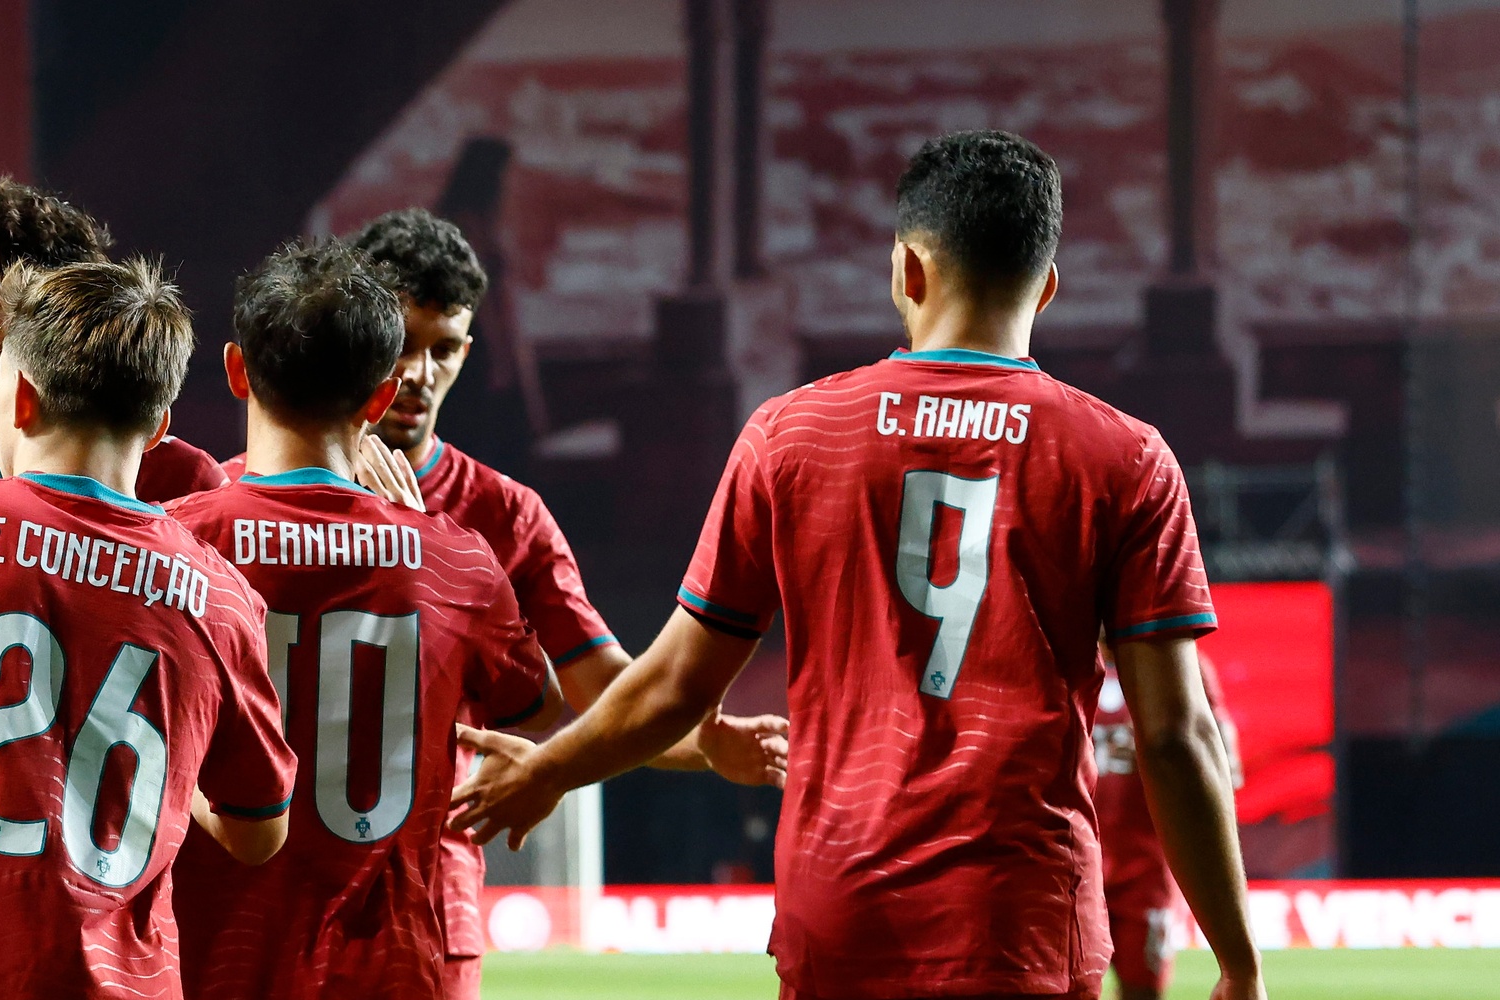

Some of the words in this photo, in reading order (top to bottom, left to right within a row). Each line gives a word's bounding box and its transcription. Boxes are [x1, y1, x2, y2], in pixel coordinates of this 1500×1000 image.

[876, 391, 906, 436] G.
[913, 395, 1032, 445] RAMOS
[15, 519, 210, 620] CONCEIÇÃO
[233, 517, 423, 570] BERNARDO
[895, 469, 1000, 700] 9
